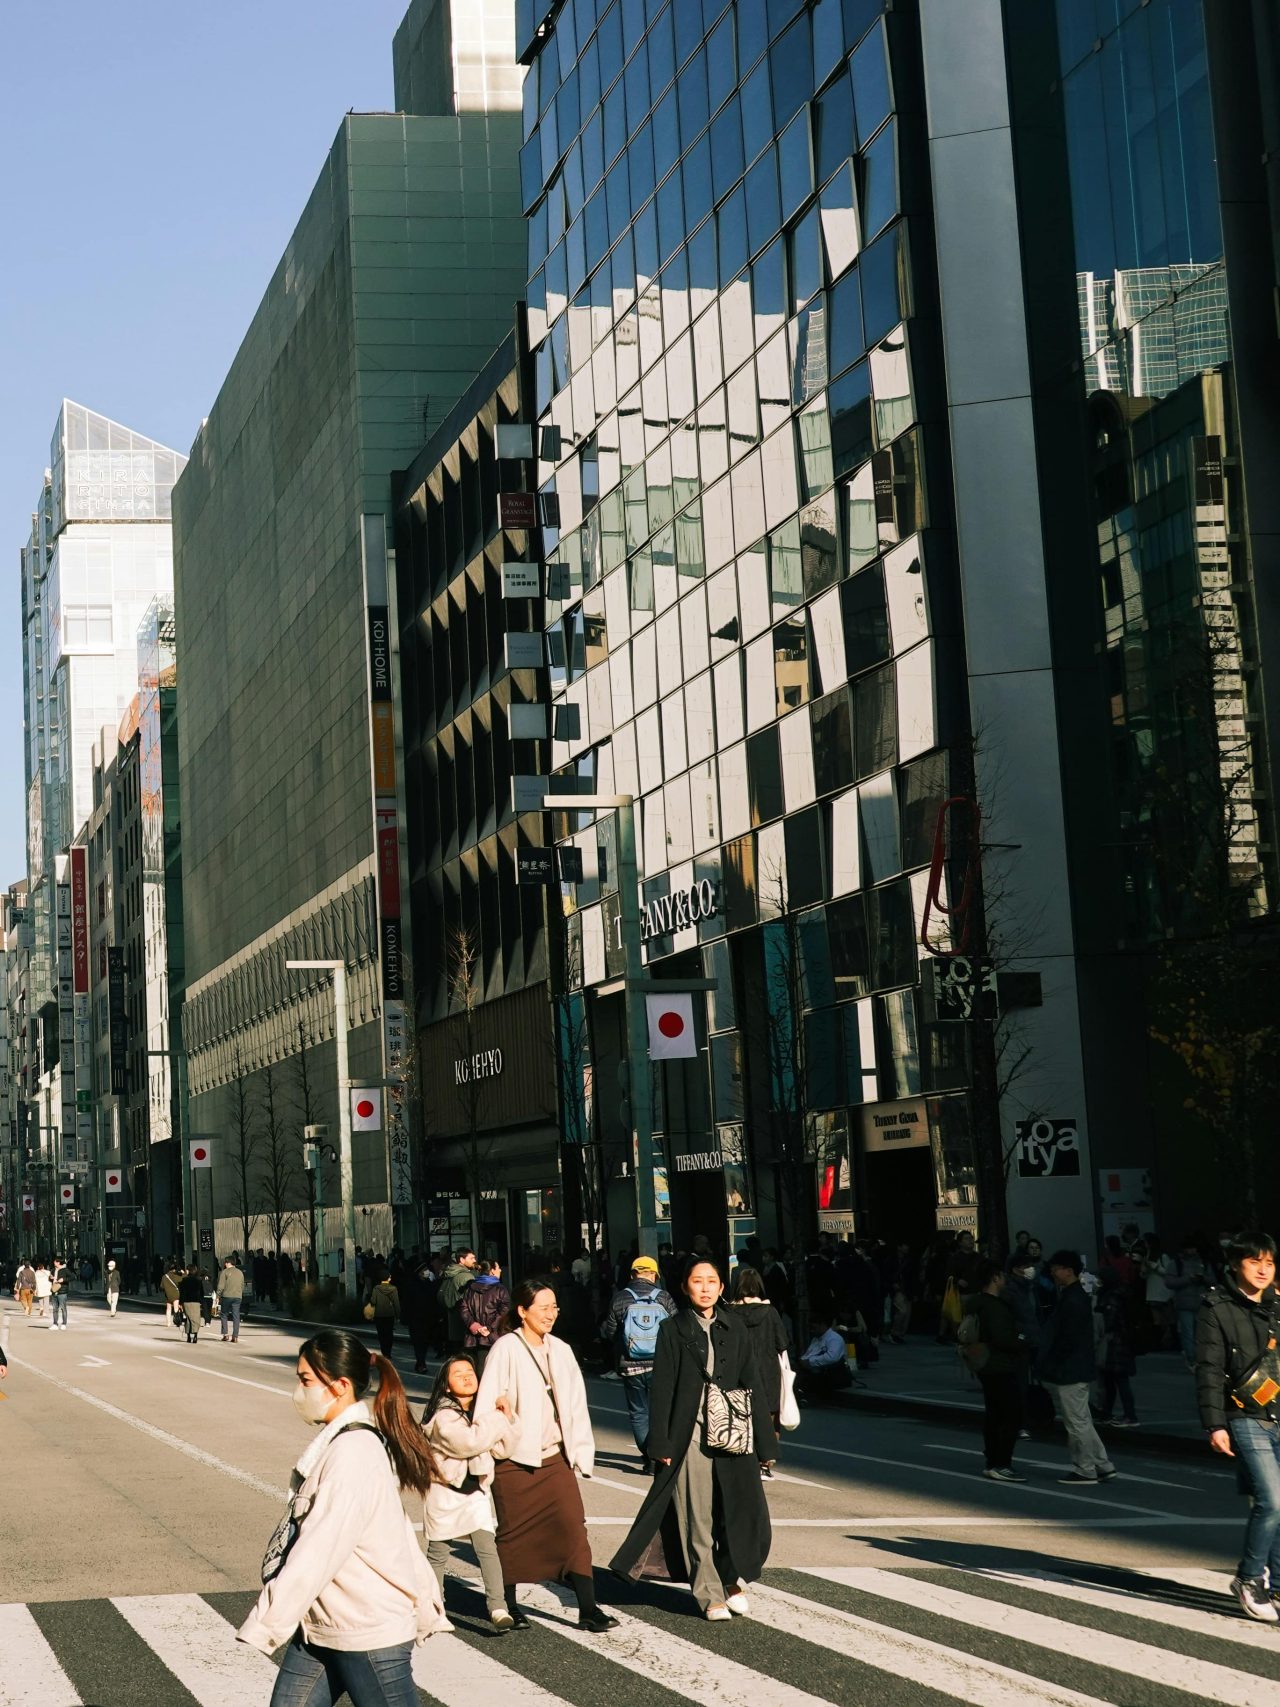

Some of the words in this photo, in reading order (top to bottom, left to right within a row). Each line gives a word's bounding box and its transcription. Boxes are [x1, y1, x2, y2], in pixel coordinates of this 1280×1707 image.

[373, 620, 387, 688] KDI-HOME
[74, 904, 86, 971] 銀座アスター
[386, 925, 398, 993] KOMEHYO
